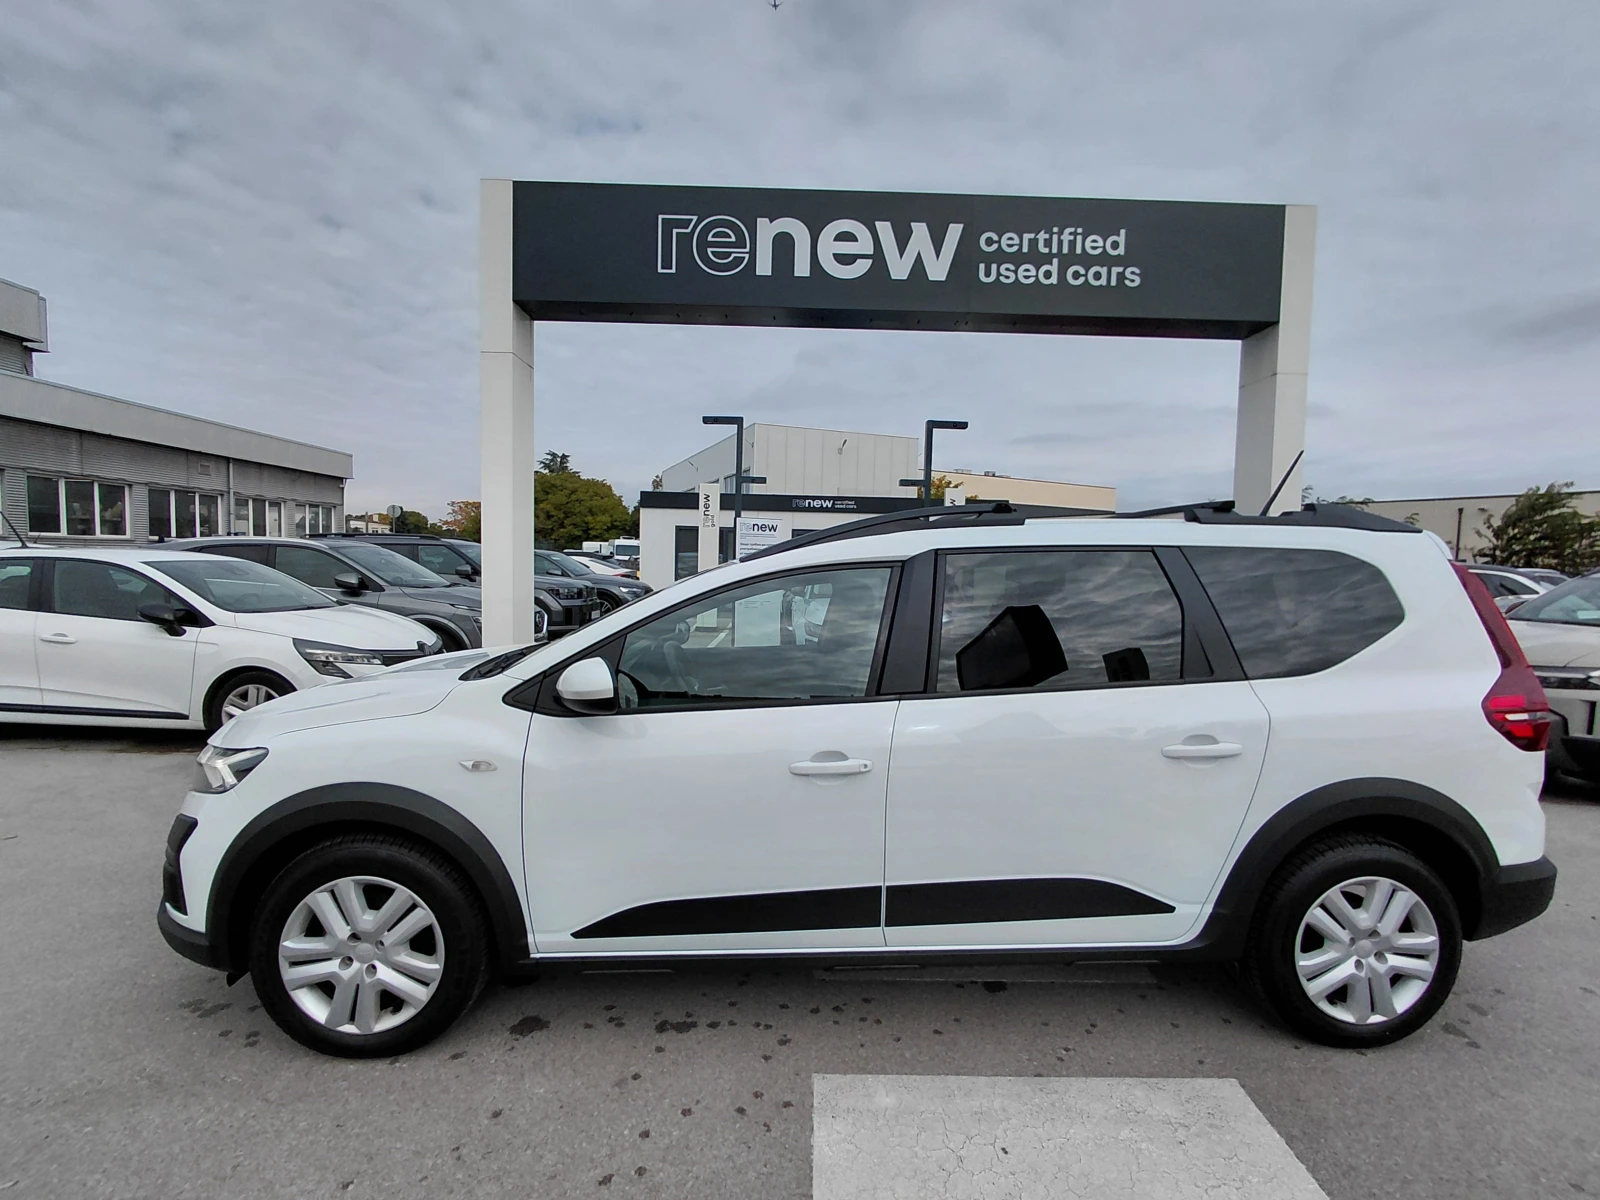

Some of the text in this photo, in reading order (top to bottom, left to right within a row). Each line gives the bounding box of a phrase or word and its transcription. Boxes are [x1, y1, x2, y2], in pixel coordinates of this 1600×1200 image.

[656, 213, 965, 282] renew
[978, 226, 1127, 256] certified
[977, 257, 1142, 288] used cars
[702, 493, 711, 528] renew
[791, 498, 834, 508] renew
[739, 522, 779, 533] renew
